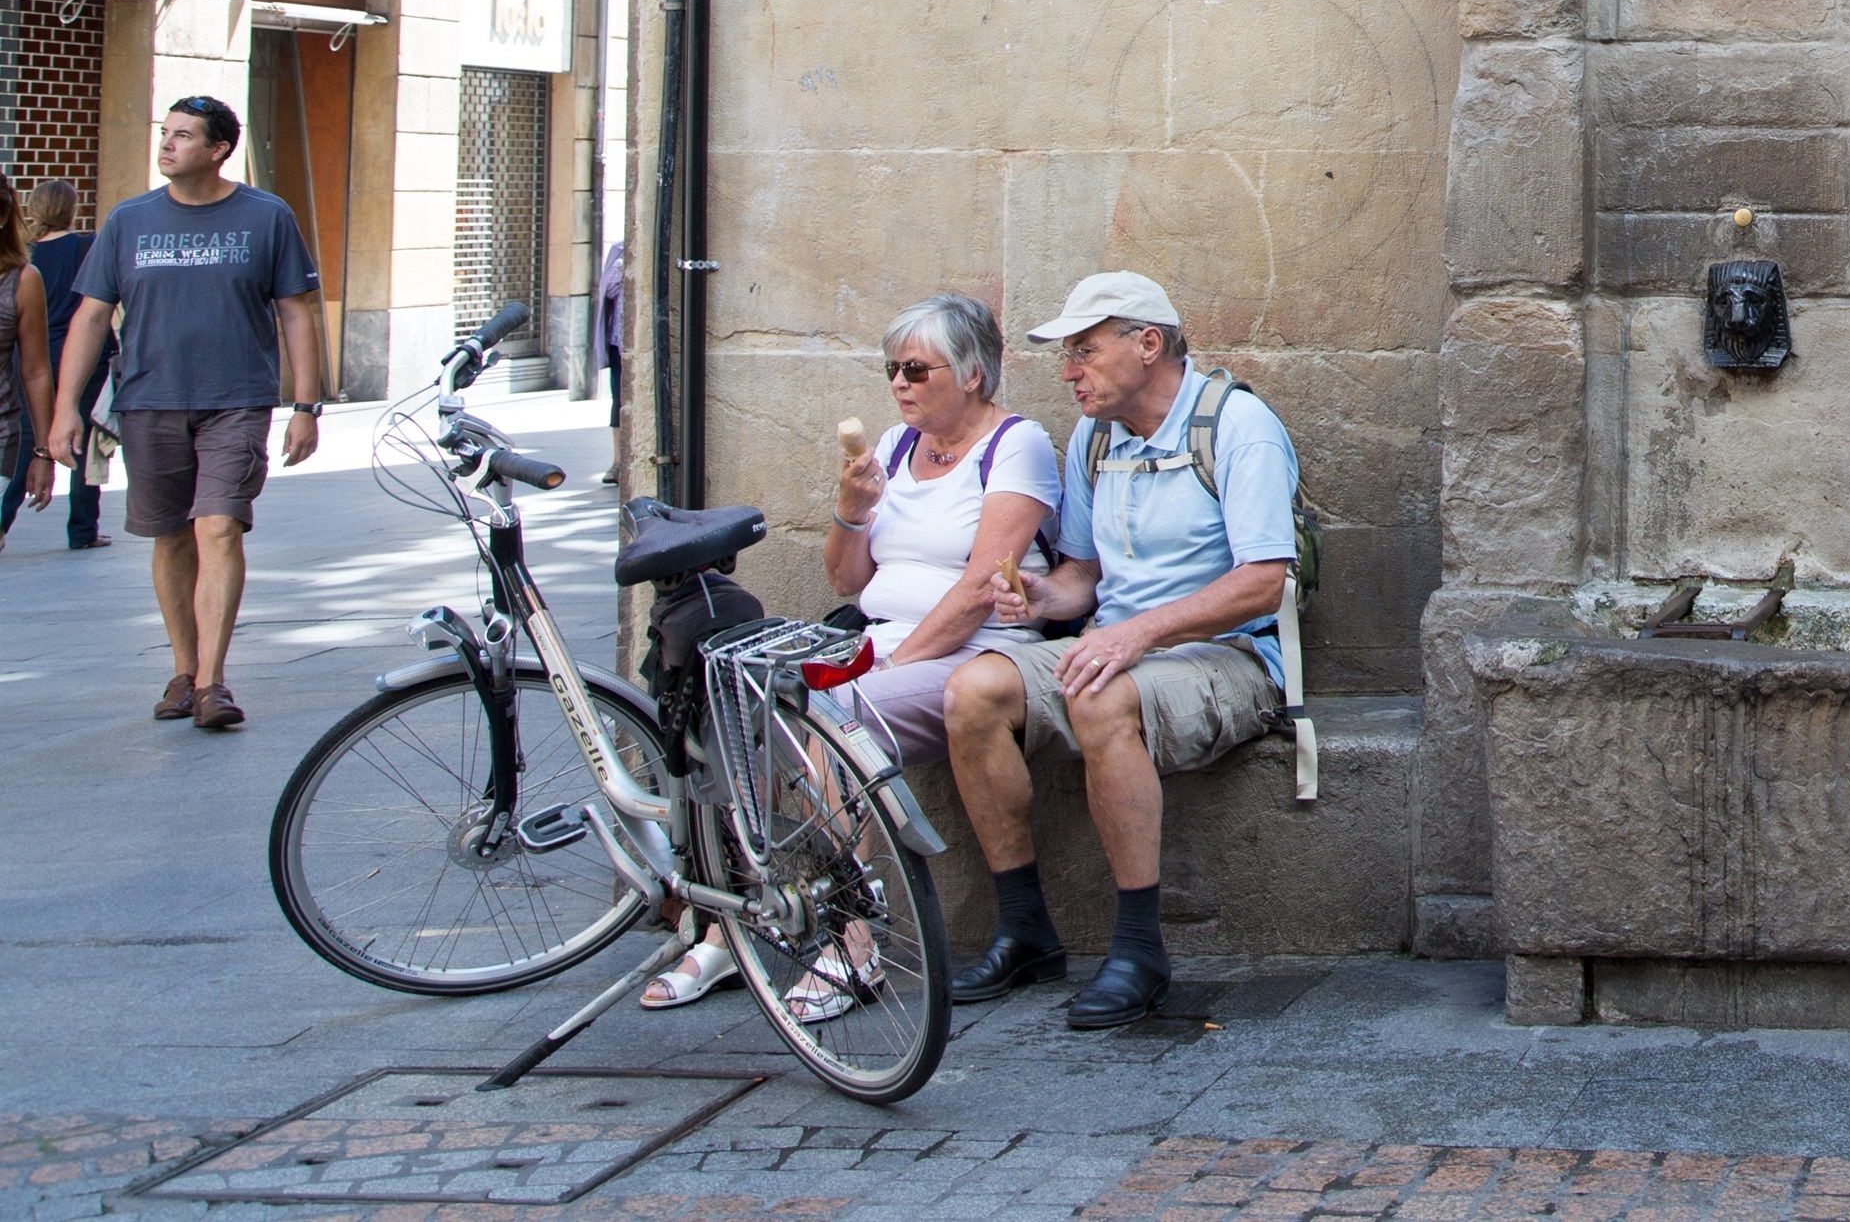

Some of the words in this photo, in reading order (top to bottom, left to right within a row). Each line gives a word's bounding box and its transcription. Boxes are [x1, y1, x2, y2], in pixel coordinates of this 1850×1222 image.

[135, 250, 175, 260] DENIM
[181, 249, 220, 259] WEAR
[219, 248, 251, 264] FRC
[137, 231, 251, 250] FORECAST
[552, 674, 609, 782] Gazelle
[329, 929, 373, 962] Gazelle
[787, 1021, 824, 1060] Gazelle
